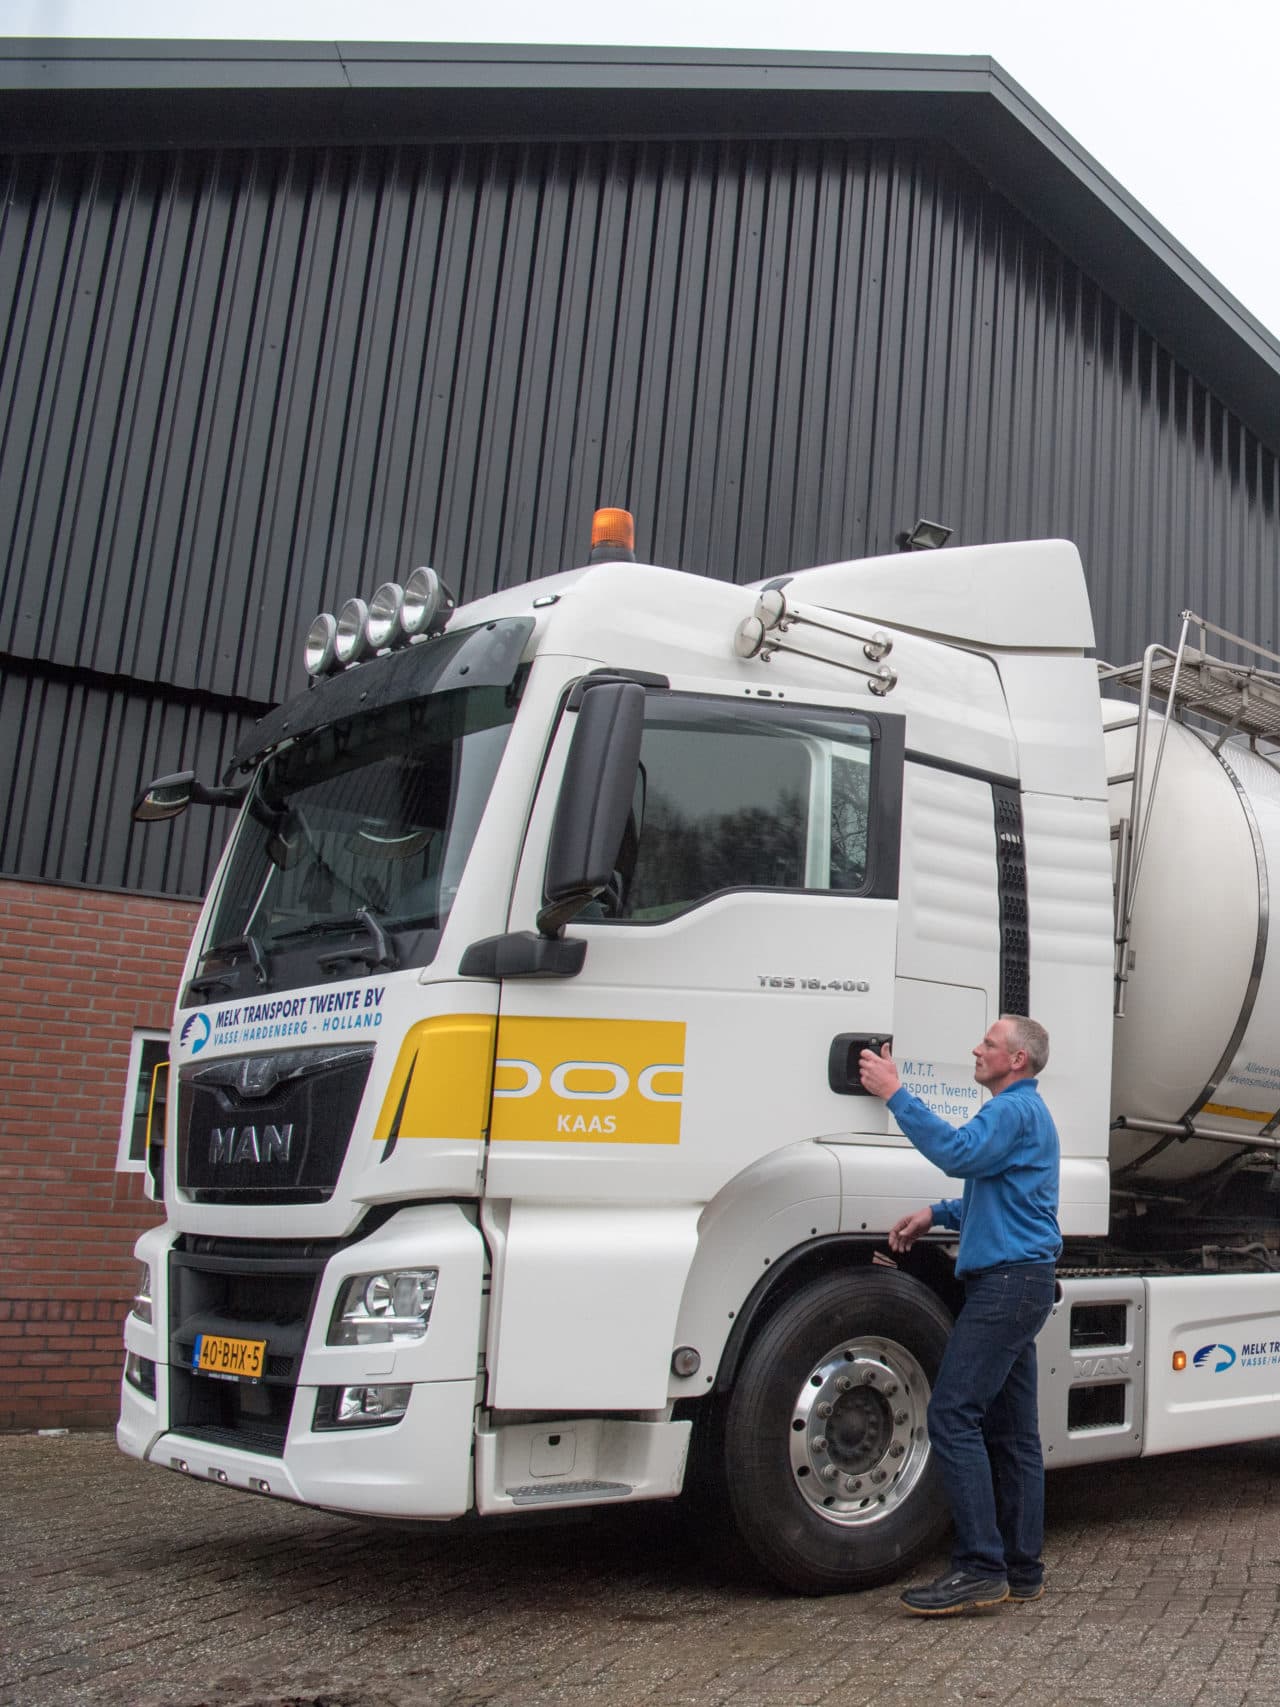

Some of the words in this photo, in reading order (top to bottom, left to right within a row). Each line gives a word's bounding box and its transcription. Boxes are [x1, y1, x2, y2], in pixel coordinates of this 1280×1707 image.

[757, 975, 795, 989] TGS
[800, 978, 870, 993] 18.400
[216, 1008, 241, 1028] MELK
[243, 998, 306, 1023] TRANSPORT
[309, 990, 361, 1014] TWENTE
[364, 987, 385, 1007] BV
[322, 1012, 383, 1031] HOLLAND
[902, 1061, 935, 1078] M.T.T.
[493, 1058, 685, 1103] DOC
[901, 1081, 938, 1097] nsport
[940, 1082, 978, 1099] Twente
[927, 1099, 969, 1119] enberg
[557, 1113, 618, 1134] KAAS
[208, 1123, 294, 1164] MAN
[203, 1340, 259, 1371] 40-BHX-5
[1241, 1342, 1268, 1356] MELK
[1072, 1356, 1129, 1379] MAN
